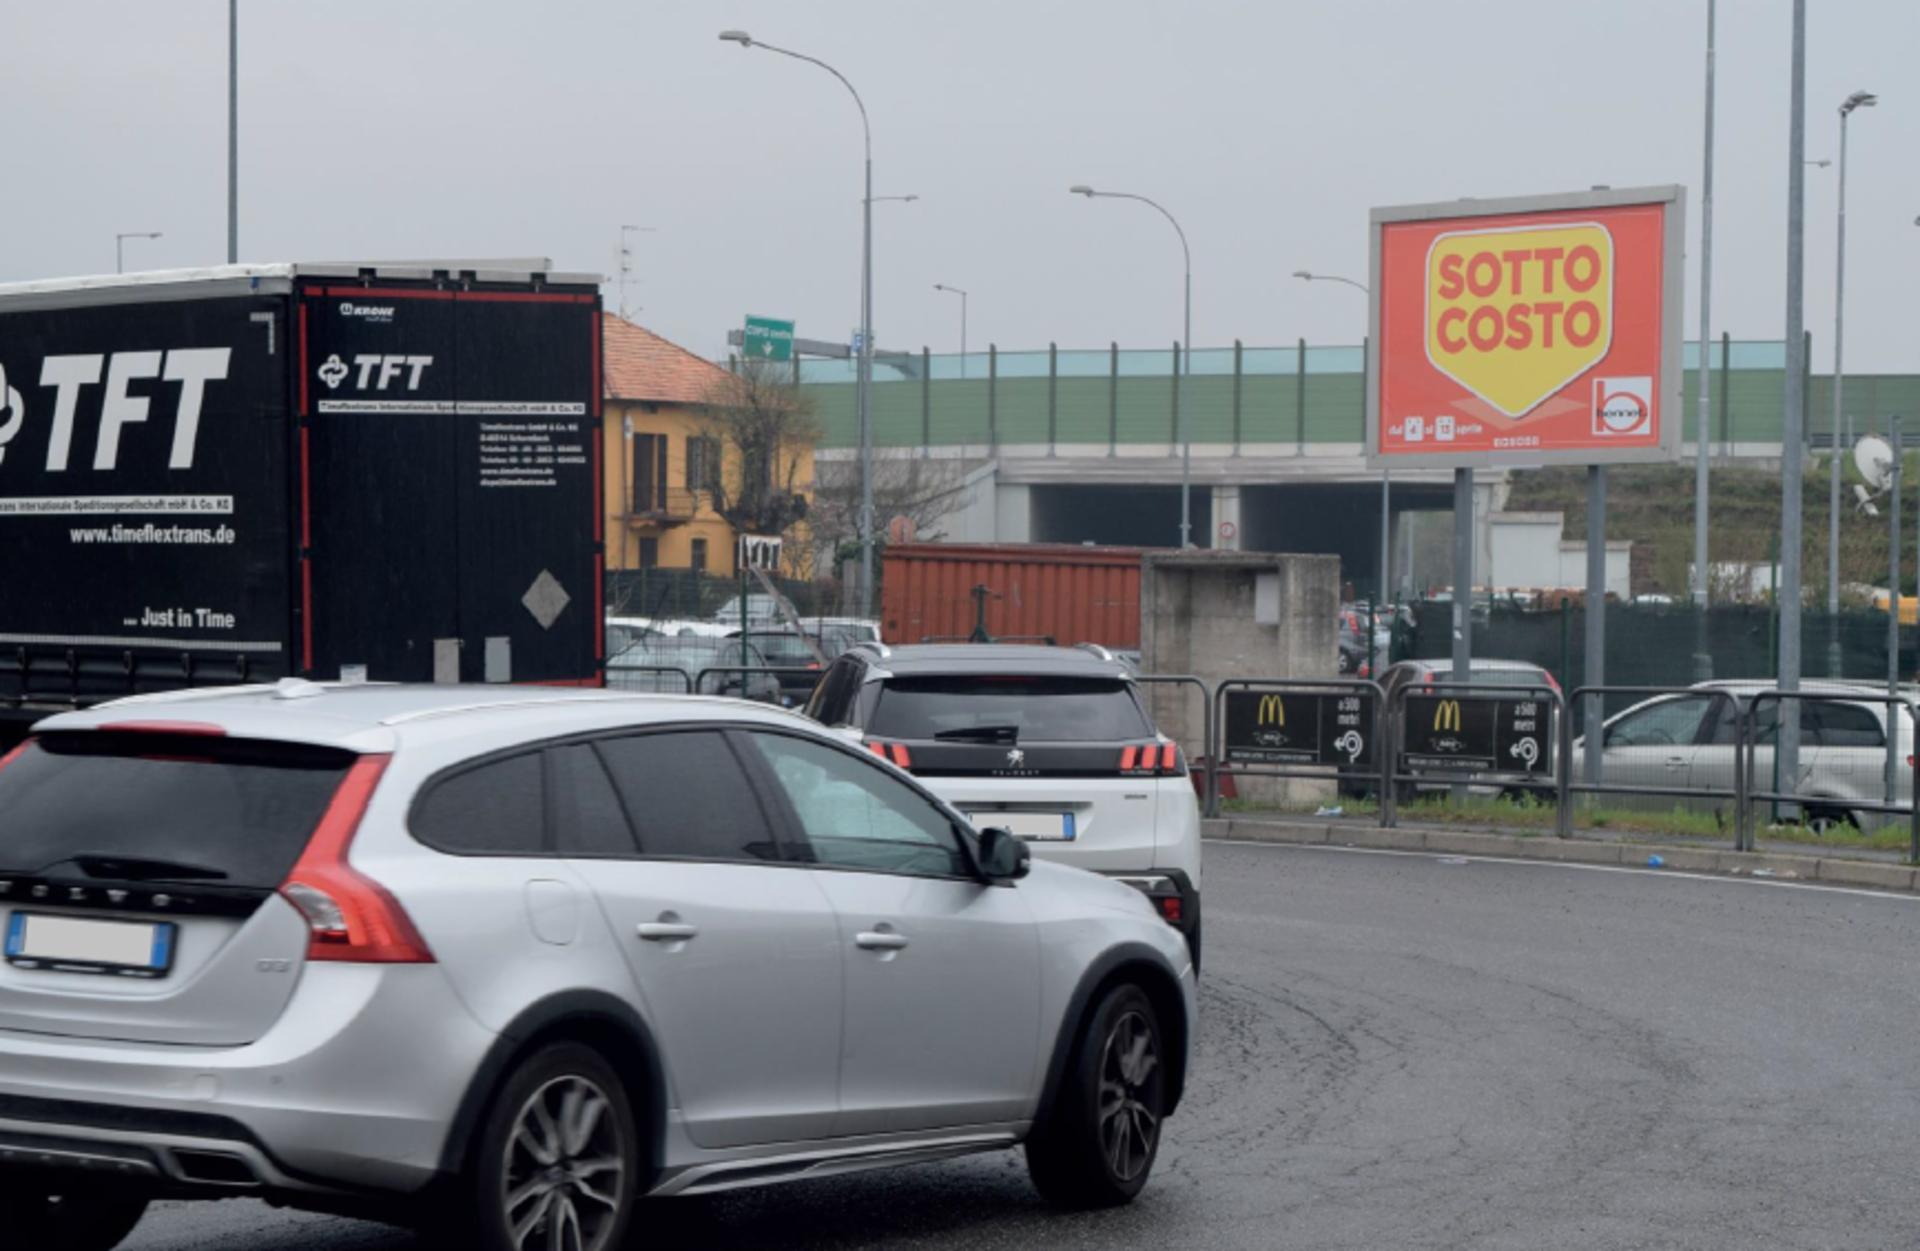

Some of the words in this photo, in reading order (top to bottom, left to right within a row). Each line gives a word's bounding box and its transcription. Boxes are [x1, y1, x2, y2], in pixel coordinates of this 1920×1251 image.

[1437, 244, 1601, 300] SOTTO
[353, 306, 395, 316] KRONE
[1436, 301, 1601, 355] COSTO
[354, 354, 434, 390] TFT
[39, 347, 232, 471] TFT
[190, 498, 198, 510] &
[216, 498, 230, 510] KG
[70, 523, 236, 543] www.timeflextrans.de
[141, 606, 174, 627] Just
[177, 608, 192, 627] in
[195, 608, 236, 628] Time
